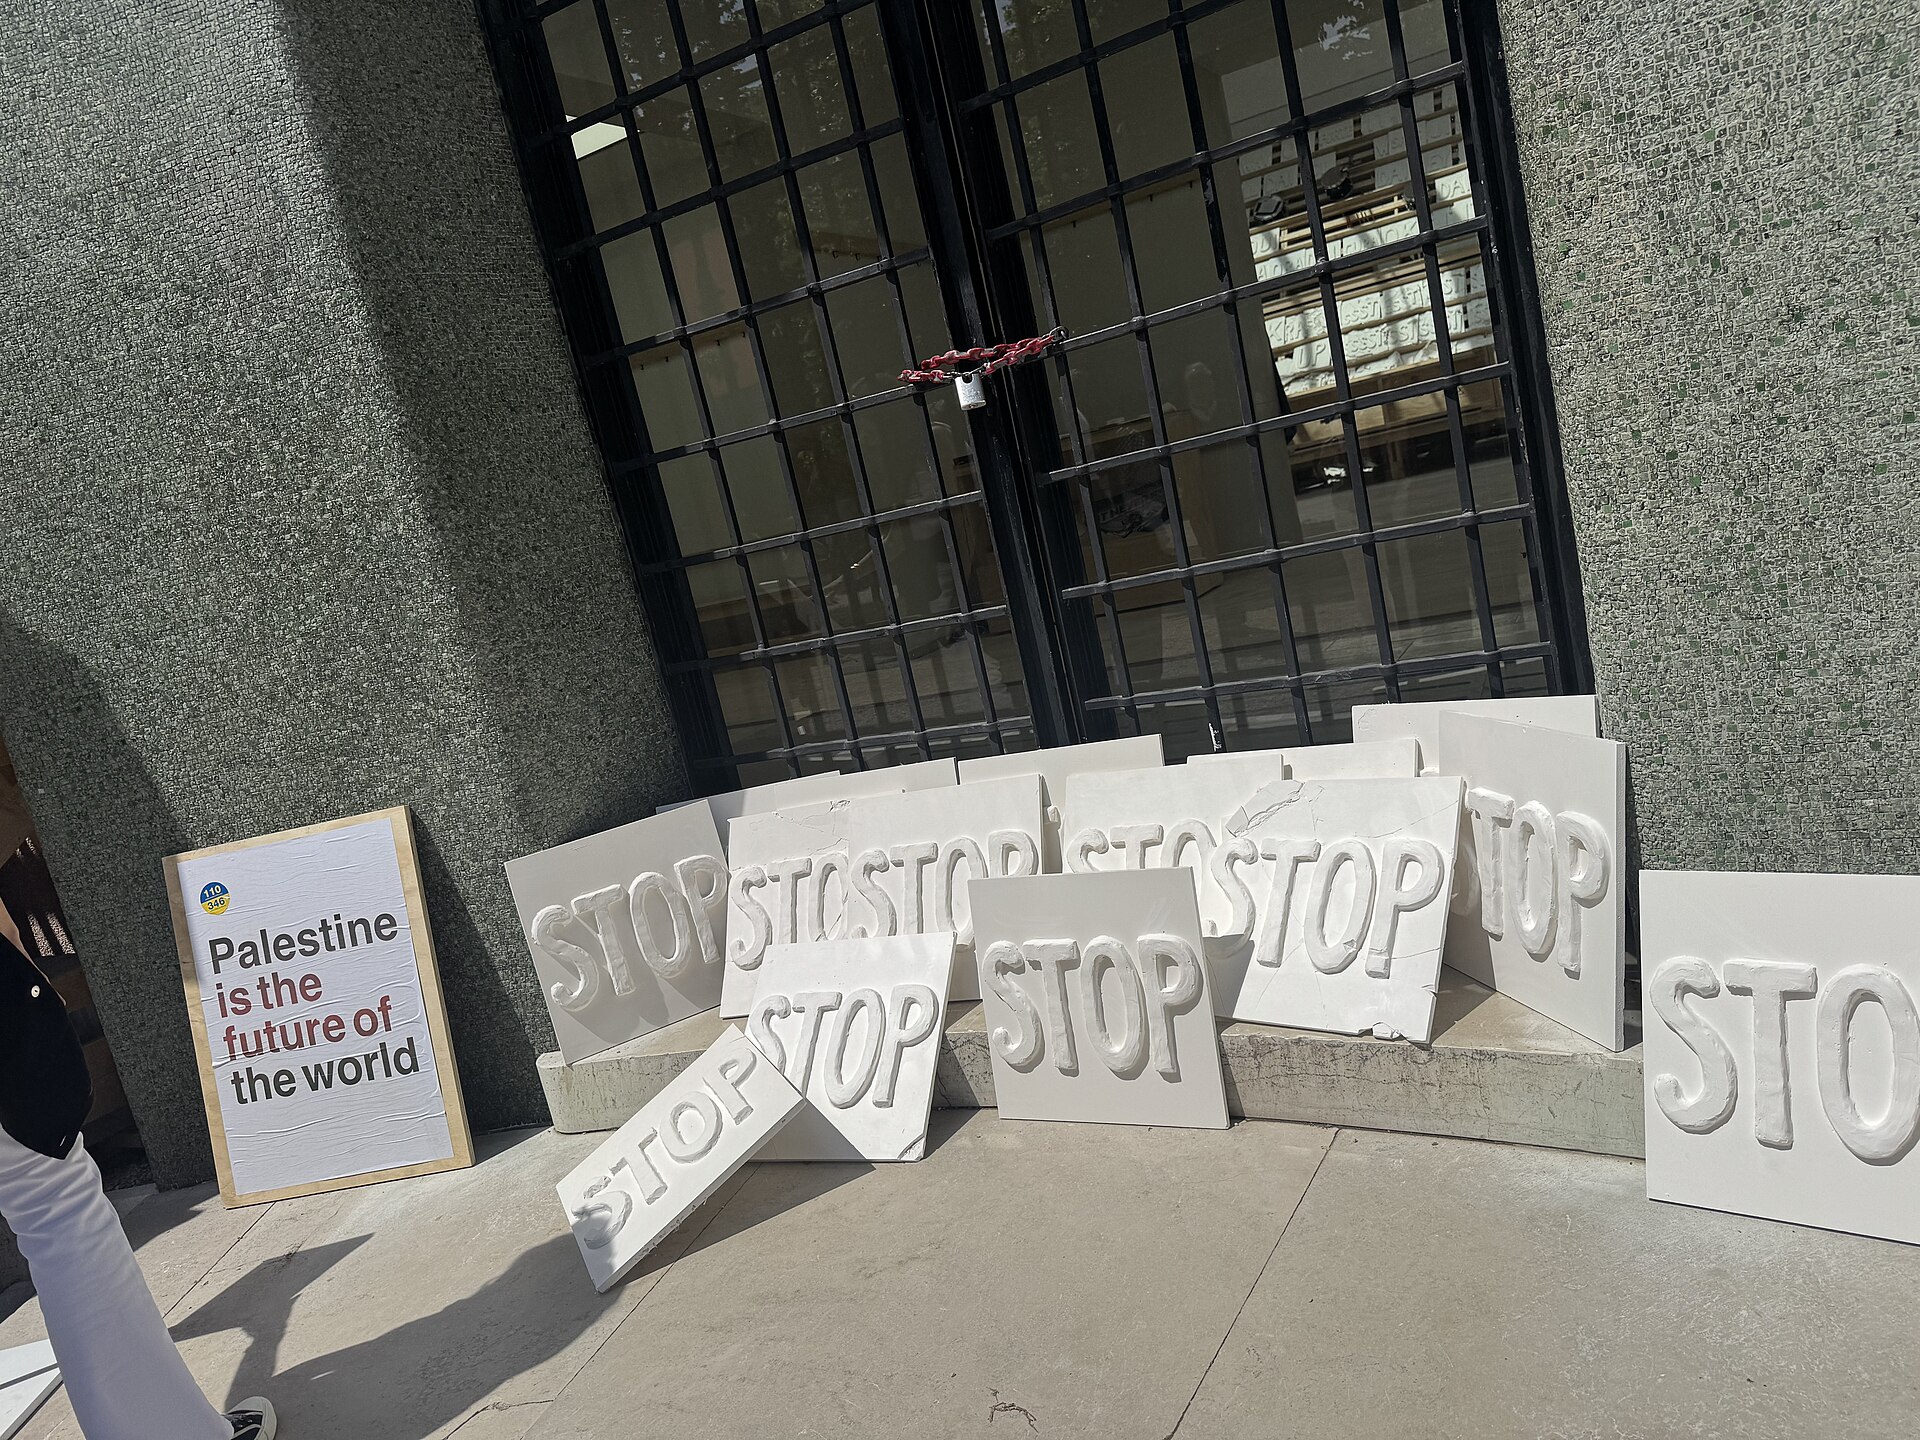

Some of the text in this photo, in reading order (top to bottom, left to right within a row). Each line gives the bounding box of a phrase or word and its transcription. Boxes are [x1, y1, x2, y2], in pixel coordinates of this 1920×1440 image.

[204, 885, 222, 898] 110
[207, 896, 226, 910] 346
[207, 913, 398, 975] Palestine
[531, 854, 731, 1013] STOP
[730, 852, 849, 971] STO
[1202, 838, 1444, 979] STOP
[215, 971, 323, 1018] is the
[223, 995, 393, 1061] future of
[748, 984, 939, 1109] STOP
[981, 933, 1205, 1078] STOP
[231, 1037, 420, 1104] the world
[1648, 955, 1920, 1165] STO
[571, 1048, 757, 1249] STOP
